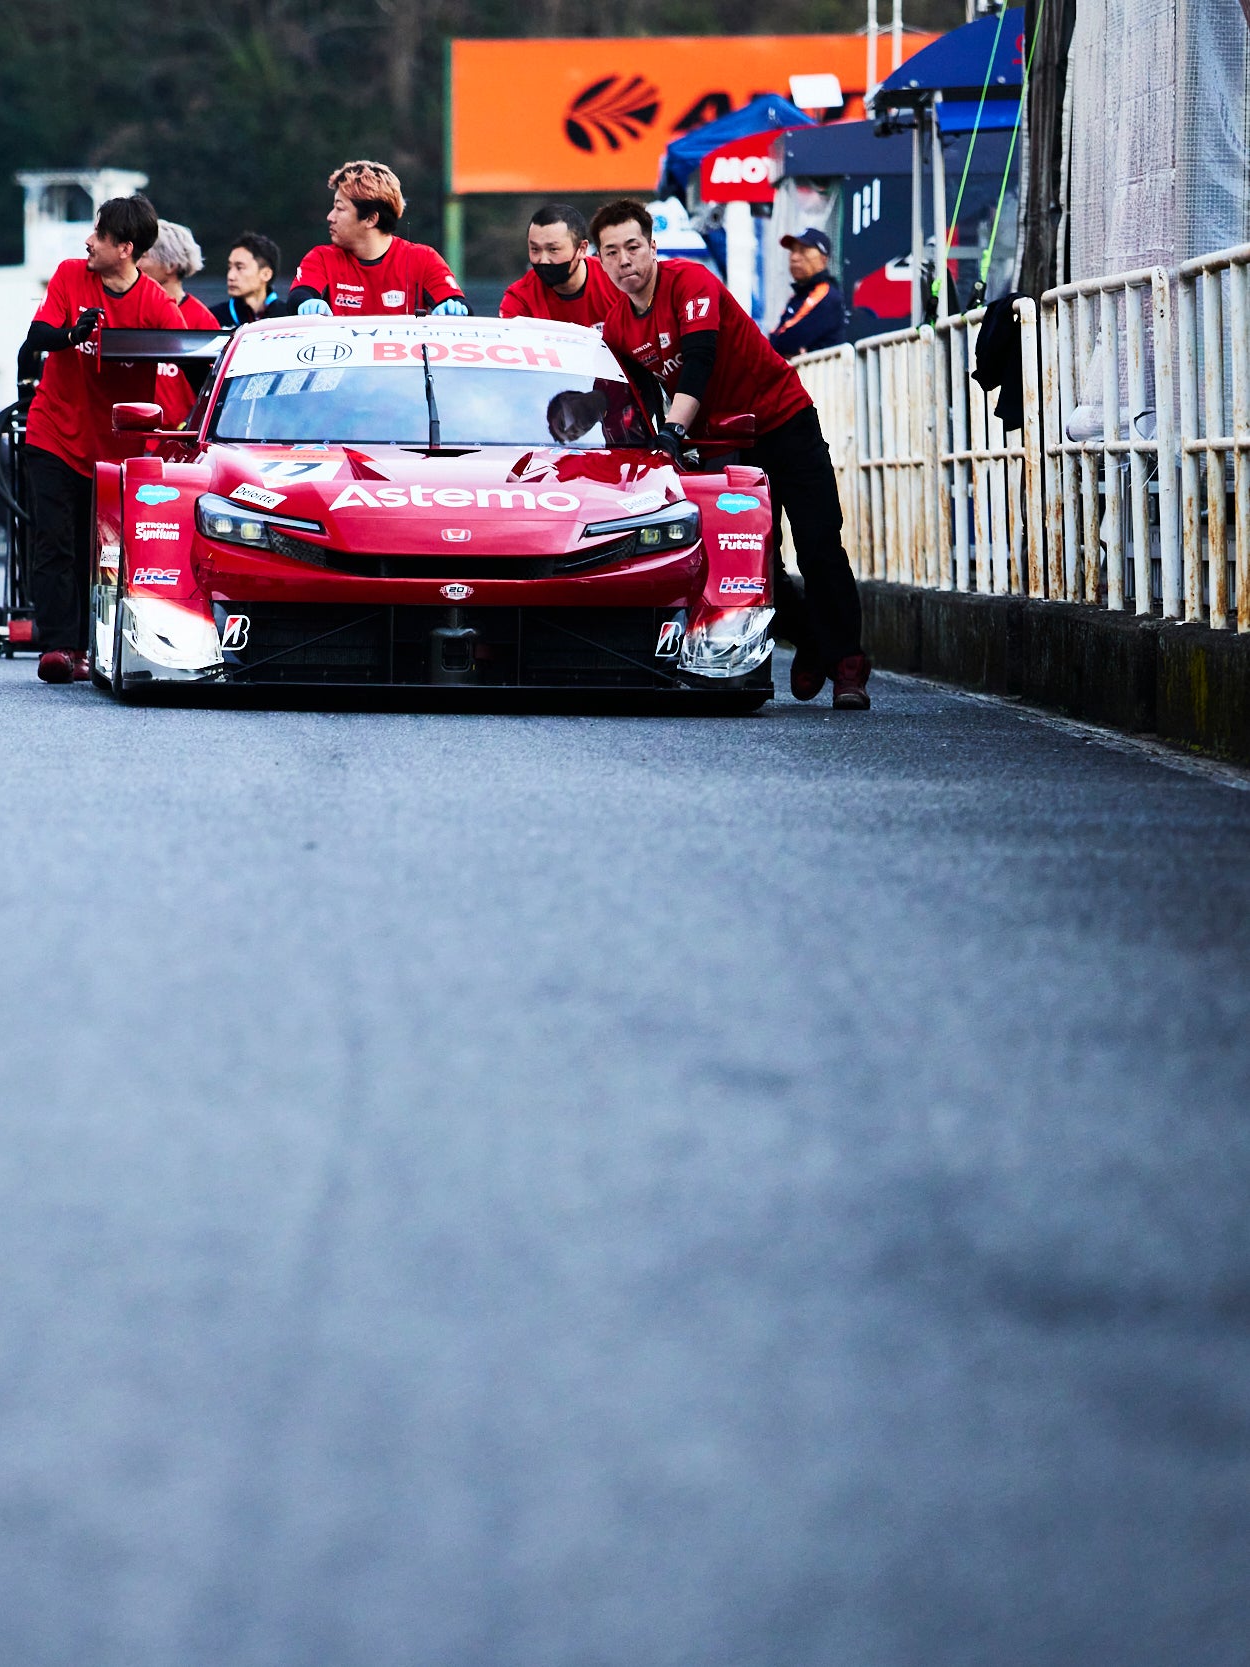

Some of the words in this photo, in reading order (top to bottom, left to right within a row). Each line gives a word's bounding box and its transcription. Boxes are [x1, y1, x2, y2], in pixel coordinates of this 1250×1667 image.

[336, 283, 365, 292] HONDA
[685, 296, 711, 321] 17
[632, 342, 653, 354] HONDA
[372, 342, 563, 368] BOSCH
[258, 461, 323, 477] 17
[235, 486, 276, 505] Deloitte
[329, 484, 581, 512] Astemo
[136, 522, 180, 530] PETRONAS
[135, 529, 180, 541] Syntium
[719, 540, 762, 551] Tutela
[133, 568, 181, 581] HRC
[719, 577, 766, 589] HRC
